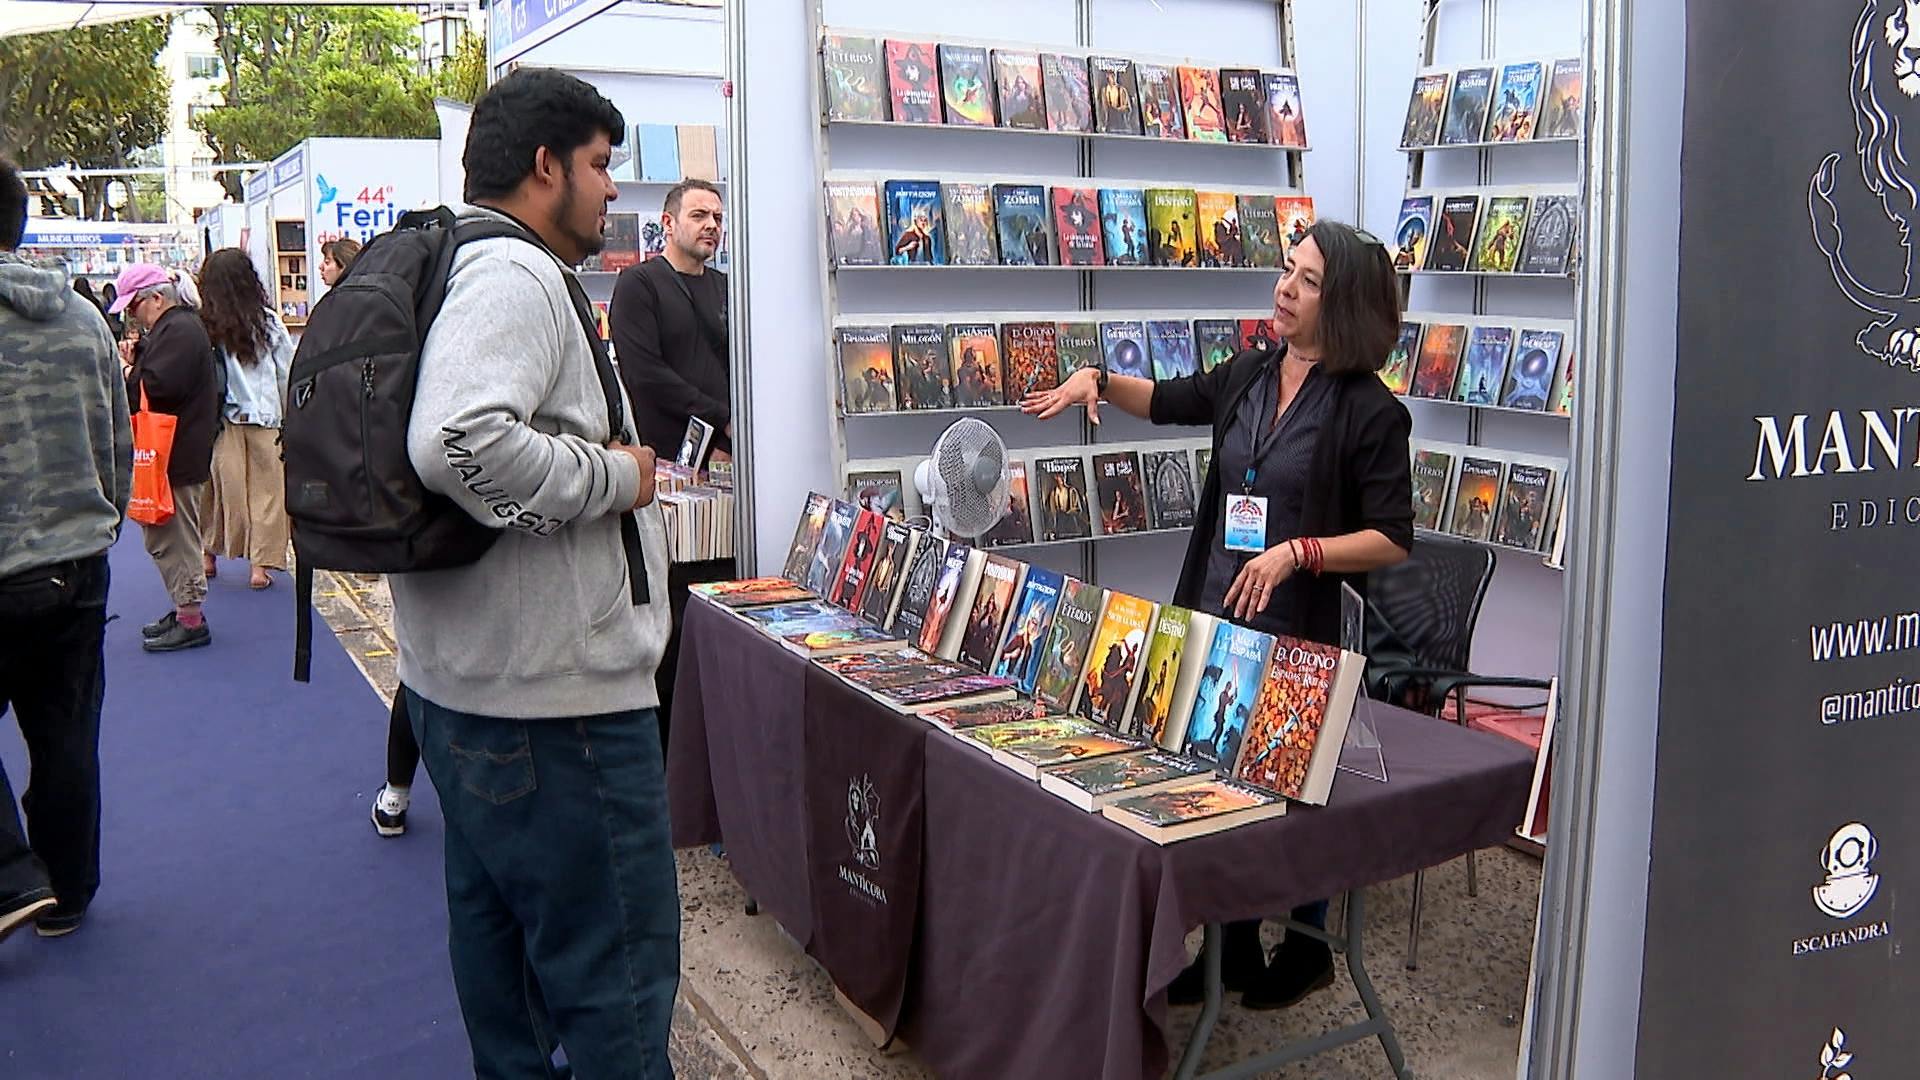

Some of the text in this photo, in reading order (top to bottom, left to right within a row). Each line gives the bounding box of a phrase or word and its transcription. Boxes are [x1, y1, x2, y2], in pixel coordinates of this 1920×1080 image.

[514, 1, 527, 32] C3
[1831, 497, 1920, 529] EDIC
[1158, 618, 1185, 638] DESTINO
[1811, 613, 1920, 661] www.m
[1229, 642, 1262, 662] ESPADA
[1275, 646, 1288, 662] EL
[1793, 921, 1889, 955] ESCAFANDRA
